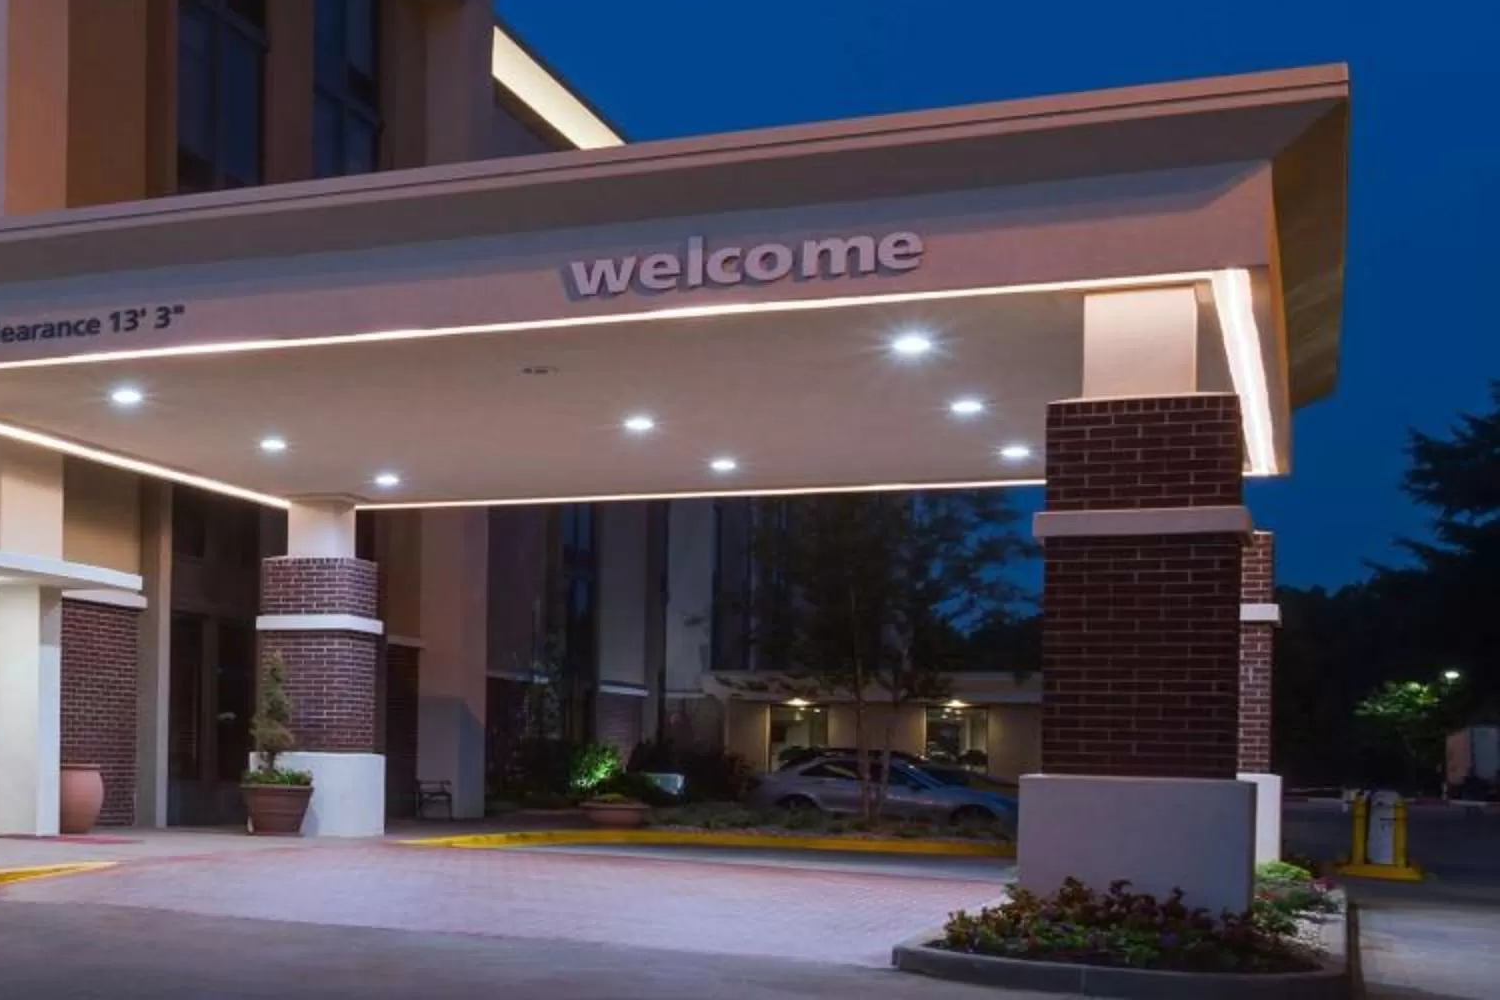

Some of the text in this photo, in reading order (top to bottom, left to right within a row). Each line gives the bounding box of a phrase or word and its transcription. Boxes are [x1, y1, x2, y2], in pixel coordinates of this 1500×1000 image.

[568, 231, 924, 297] welcome
[108, 306, 147, 333] 13'
[153, 303, 185, 329] 3"
